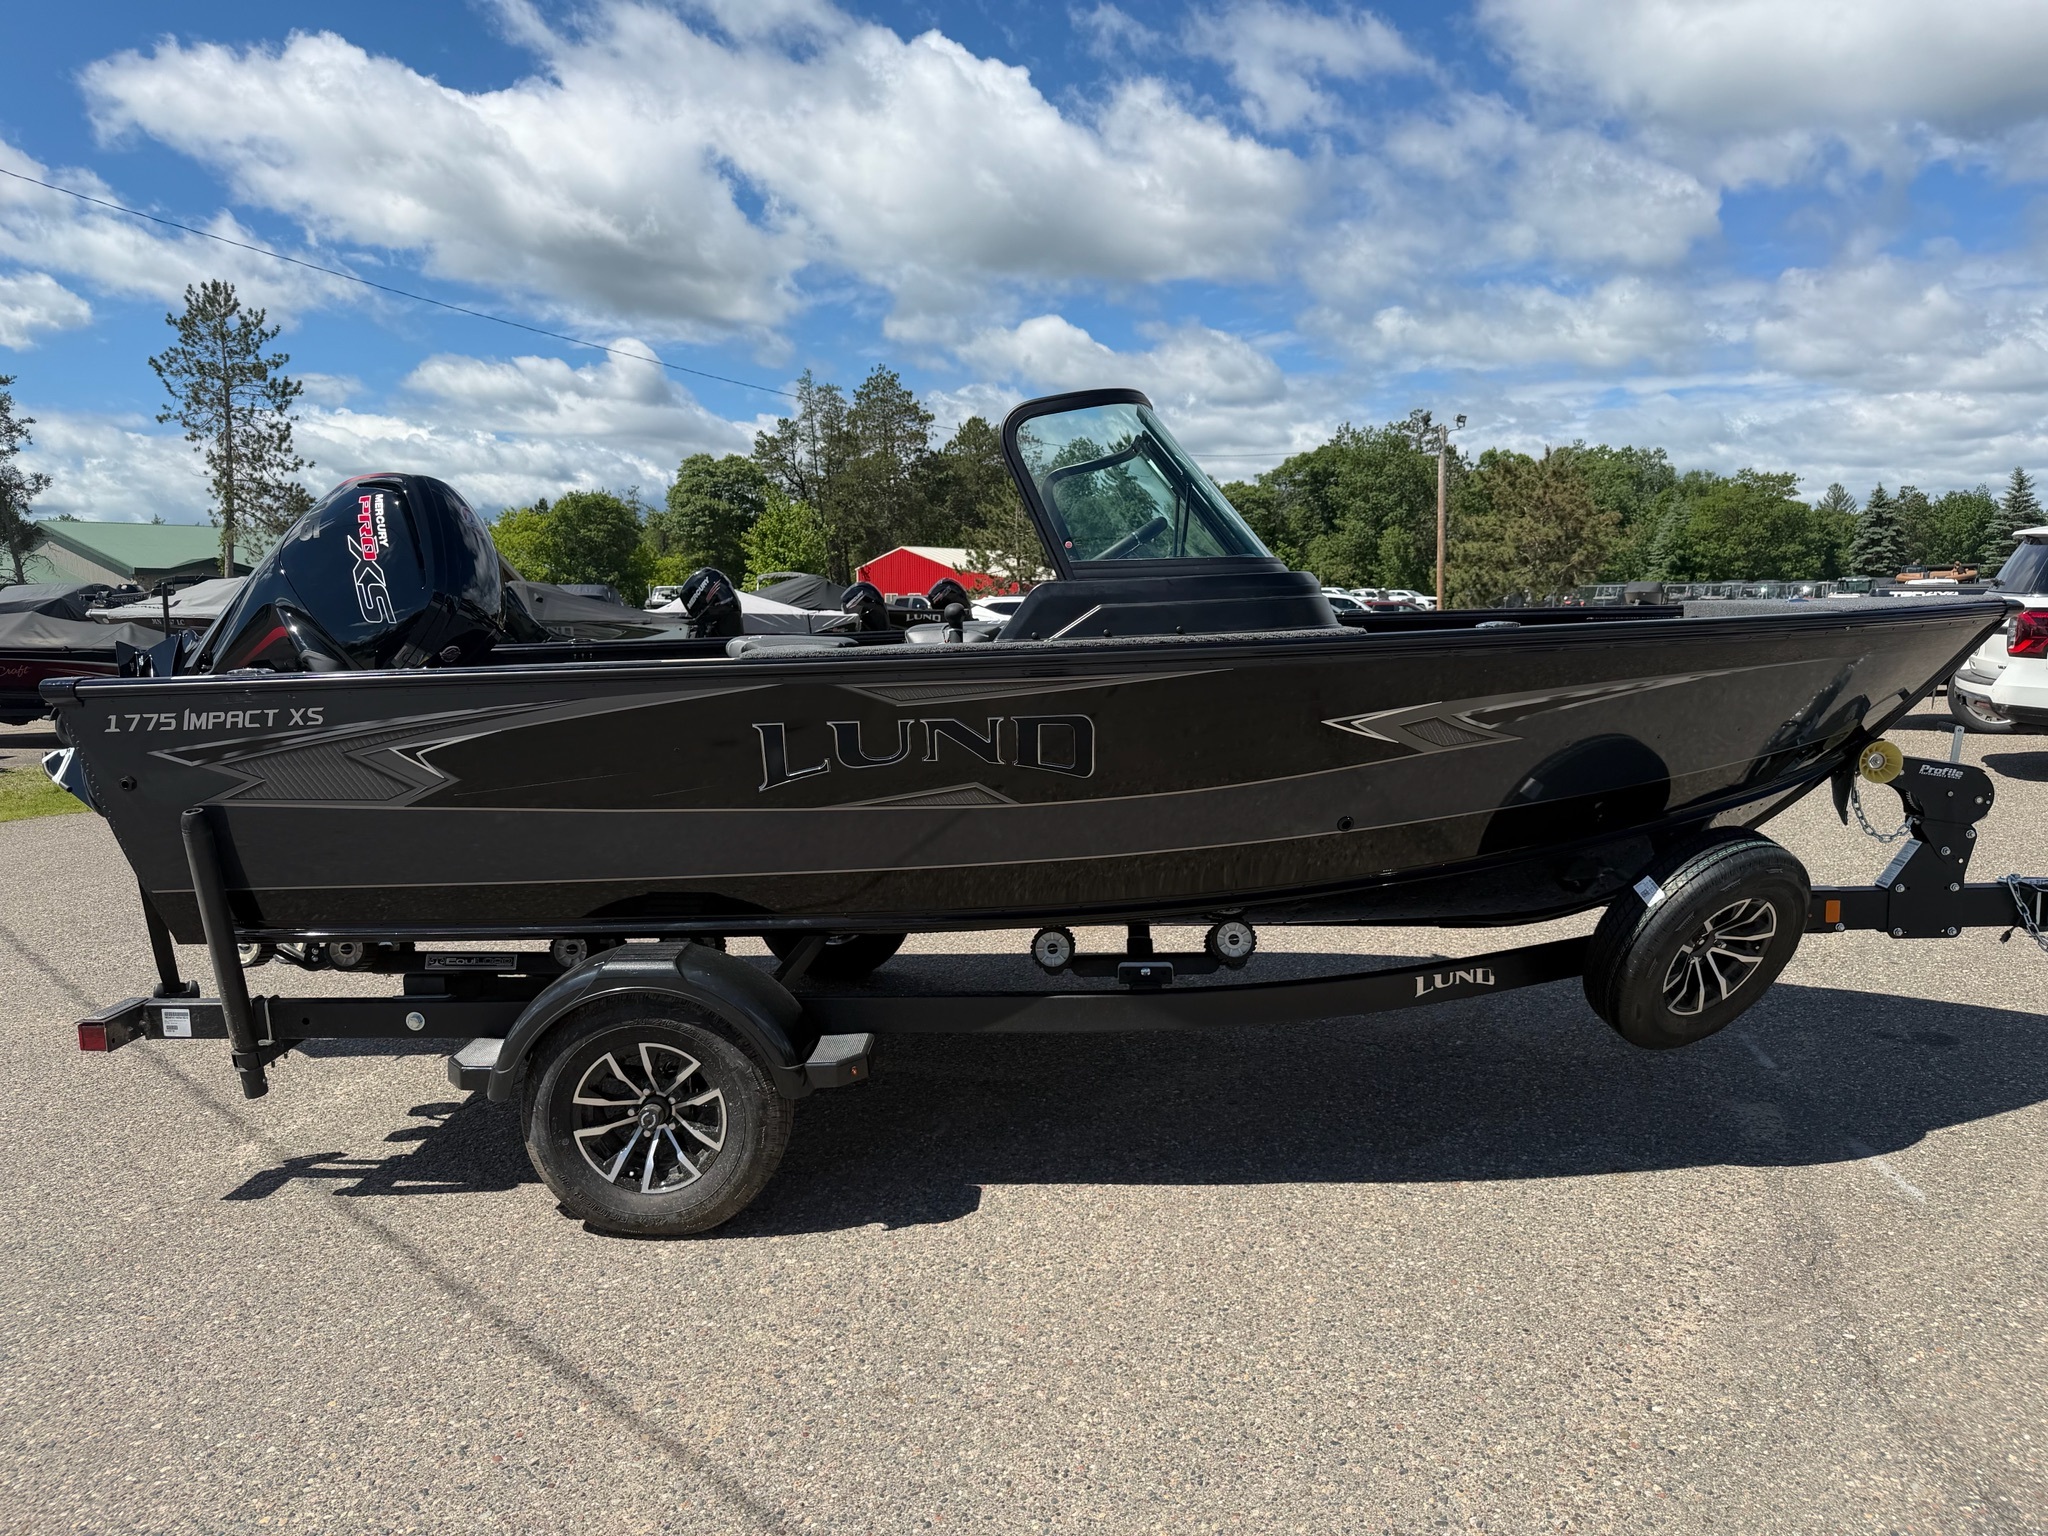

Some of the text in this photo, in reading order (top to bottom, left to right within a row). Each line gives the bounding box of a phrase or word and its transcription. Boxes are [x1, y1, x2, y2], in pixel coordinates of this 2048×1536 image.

[374, 493, 389, 547] MERCURY
[347, 495, 397, 624] PRO XS
[686, 576, 709, 609] MERCURY
[905, 613, 941, 622] LUND
[104, 706, 325, 733] 1775 IMPACT XS
[751, 714, 1096, 793] LUND
[1919, 764, 1964, 778] Profile
[1414, 967, 1495, 998] LUND
